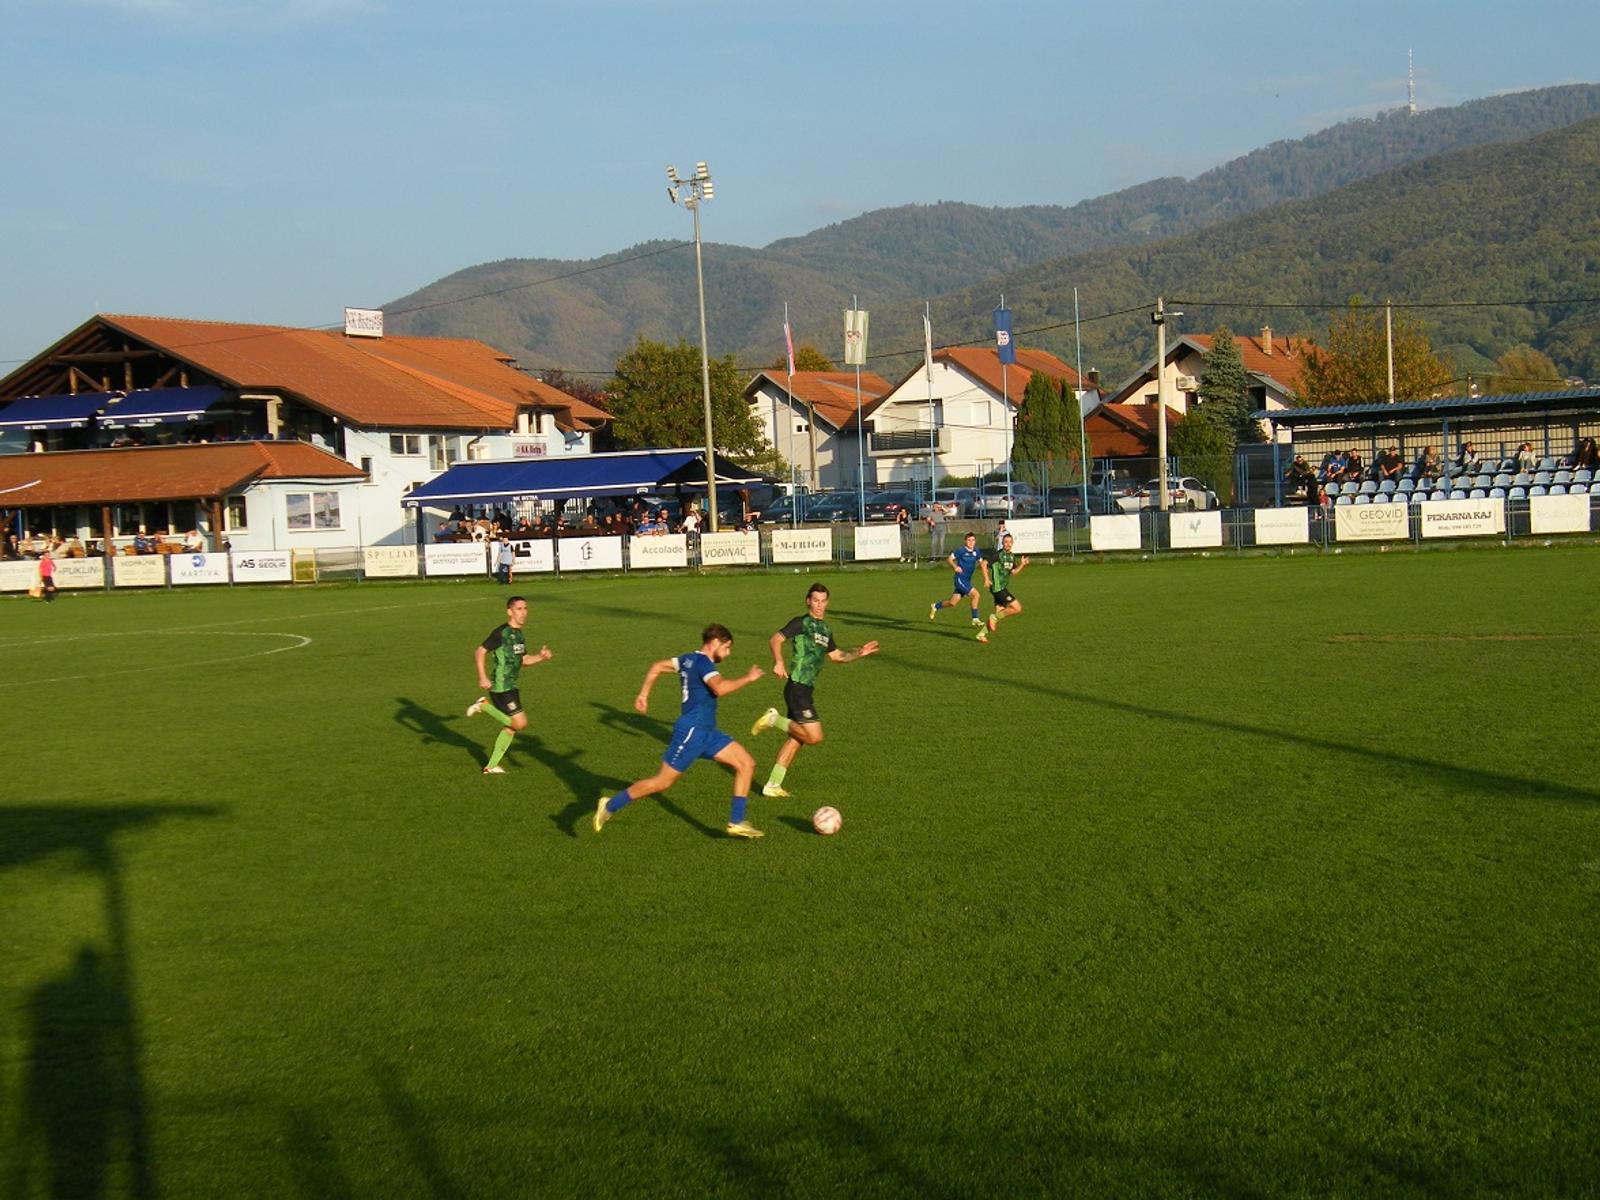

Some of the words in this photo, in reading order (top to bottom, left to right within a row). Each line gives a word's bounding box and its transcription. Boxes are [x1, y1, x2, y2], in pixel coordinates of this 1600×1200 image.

[1359, 508, 1403, 521] GEOVID
[1427, 512, 1472, 522] PEKARNA
[1473, 511, 1492, 520] KAJ
[642, 544, 684, 554] Accolade
[240, 559, 256, 569] AS
